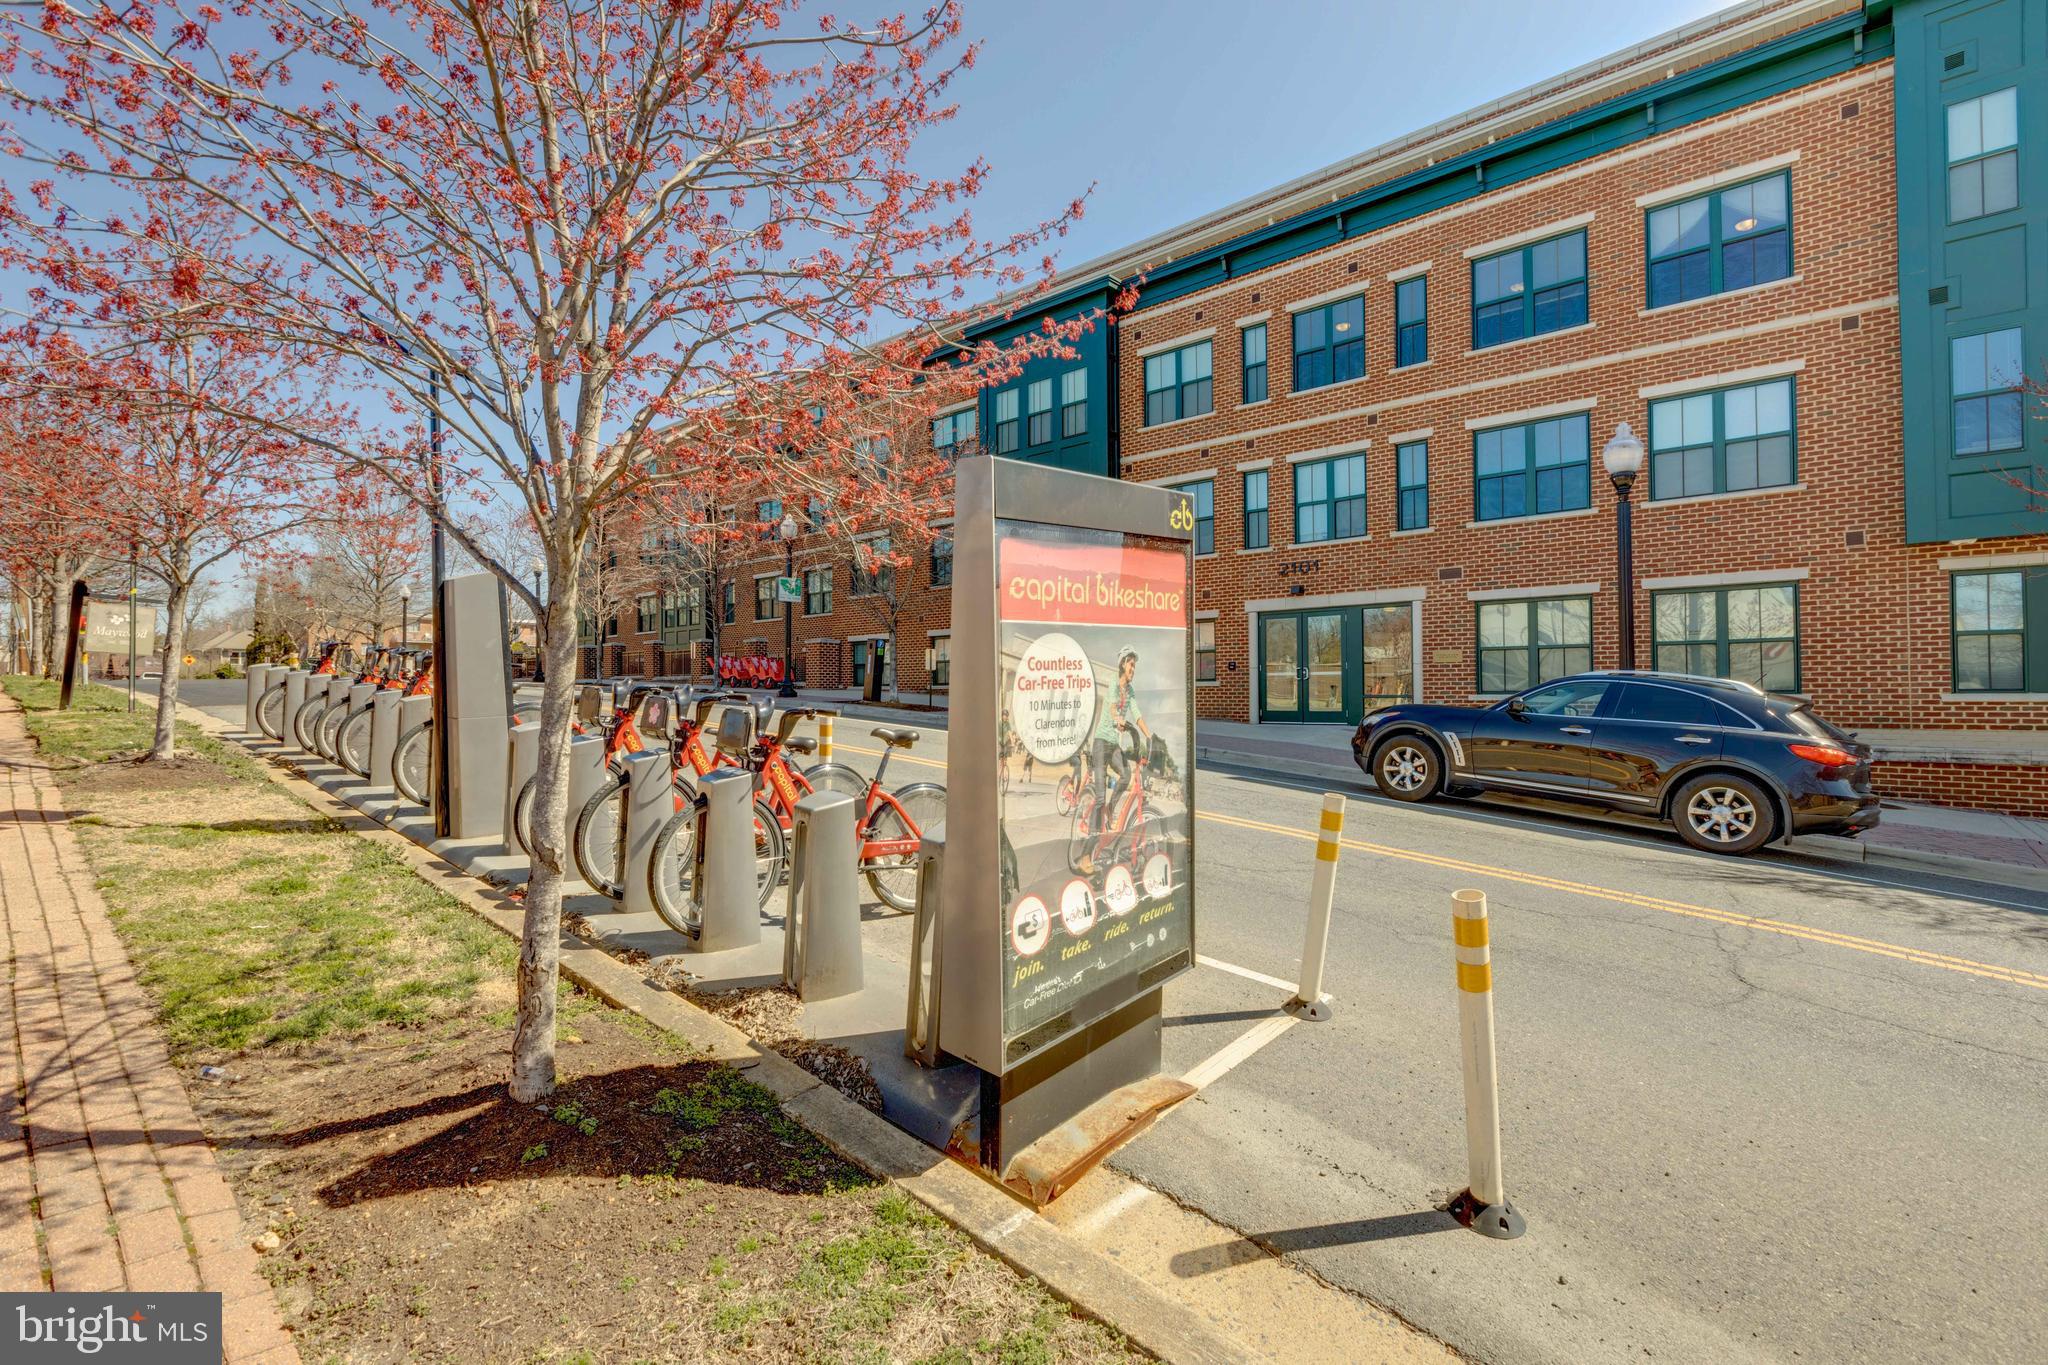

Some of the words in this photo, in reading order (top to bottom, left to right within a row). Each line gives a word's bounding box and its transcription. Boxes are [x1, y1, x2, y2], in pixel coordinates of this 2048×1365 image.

[1009, 575, 1089, 609] capital
[1096, 573, 1181, 612] bikeshare
[93, 625, 148, 639] Maywod
[1027, 656, 1083, 671] Countless
[1017, 675, 1065, 691] Car-Free
[1066, 674, 1092, 692] Trips
[1029, 701, 1039, 711] 10
[1040, 700, 1072, 710] Minutes
[1073, 700, 1082, 709] to
[1035, 718, 1076, 730] Clarendon
[1036, 737, 1056, 748] from
[1057, 735, 1077, 746] here!
[774, 767, 797, 801] capital
[1012, 959, 1045, 988] join.
[1061, 938, 1092, 960] take.
[1104, 920, 1129, 941] ride.
[1139, 902, 1175, 925] return.
